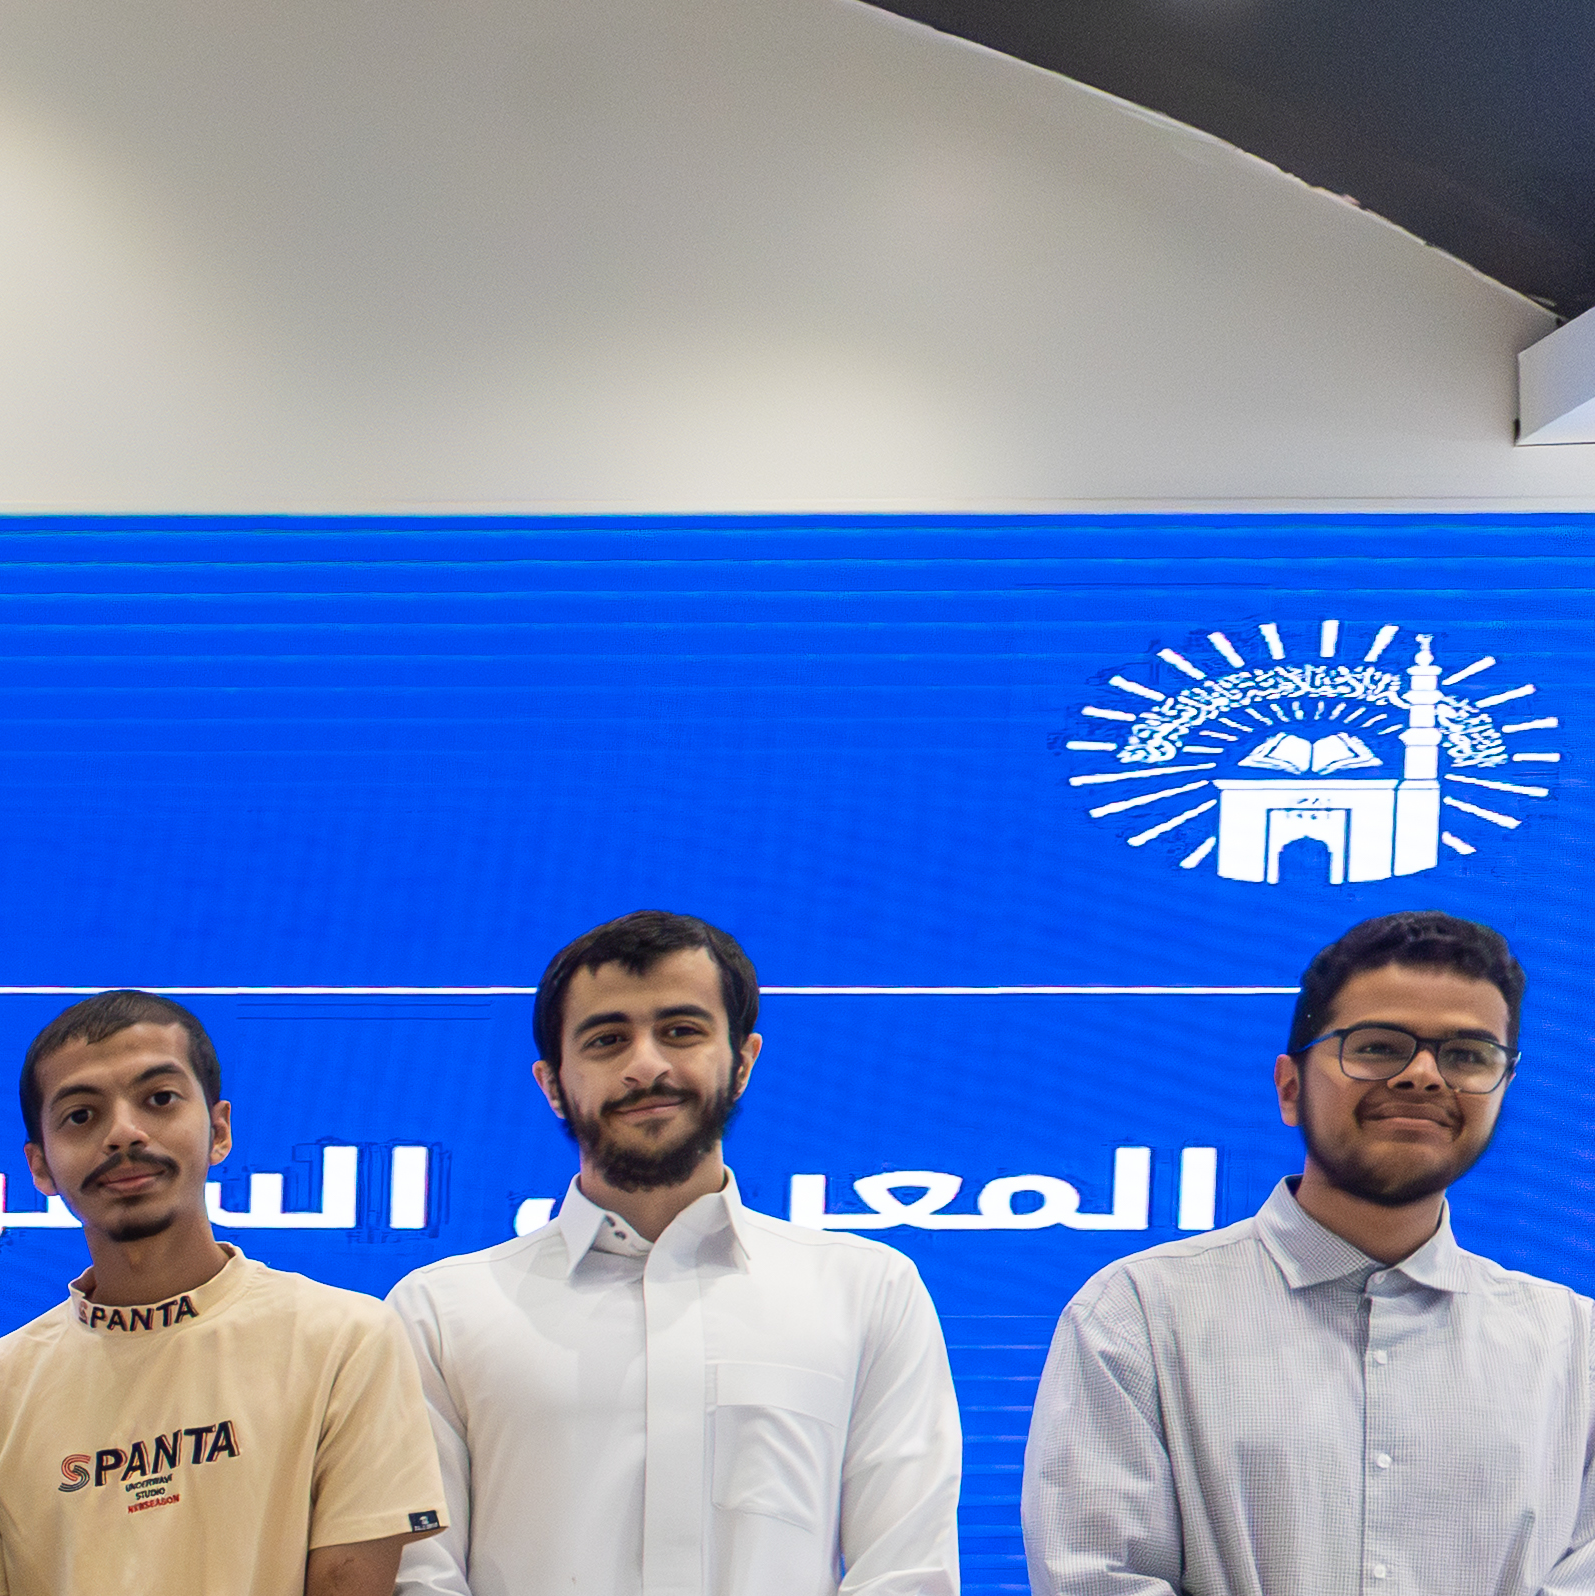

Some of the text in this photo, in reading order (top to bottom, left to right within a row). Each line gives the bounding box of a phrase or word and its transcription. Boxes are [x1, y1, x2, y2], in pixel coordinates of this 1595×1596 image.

[78, 1295, 199, 1332] SPANTA
[58, 1419, 241, 1493] SPANTA
[135, 1486, 166, 1501] STUDIO
